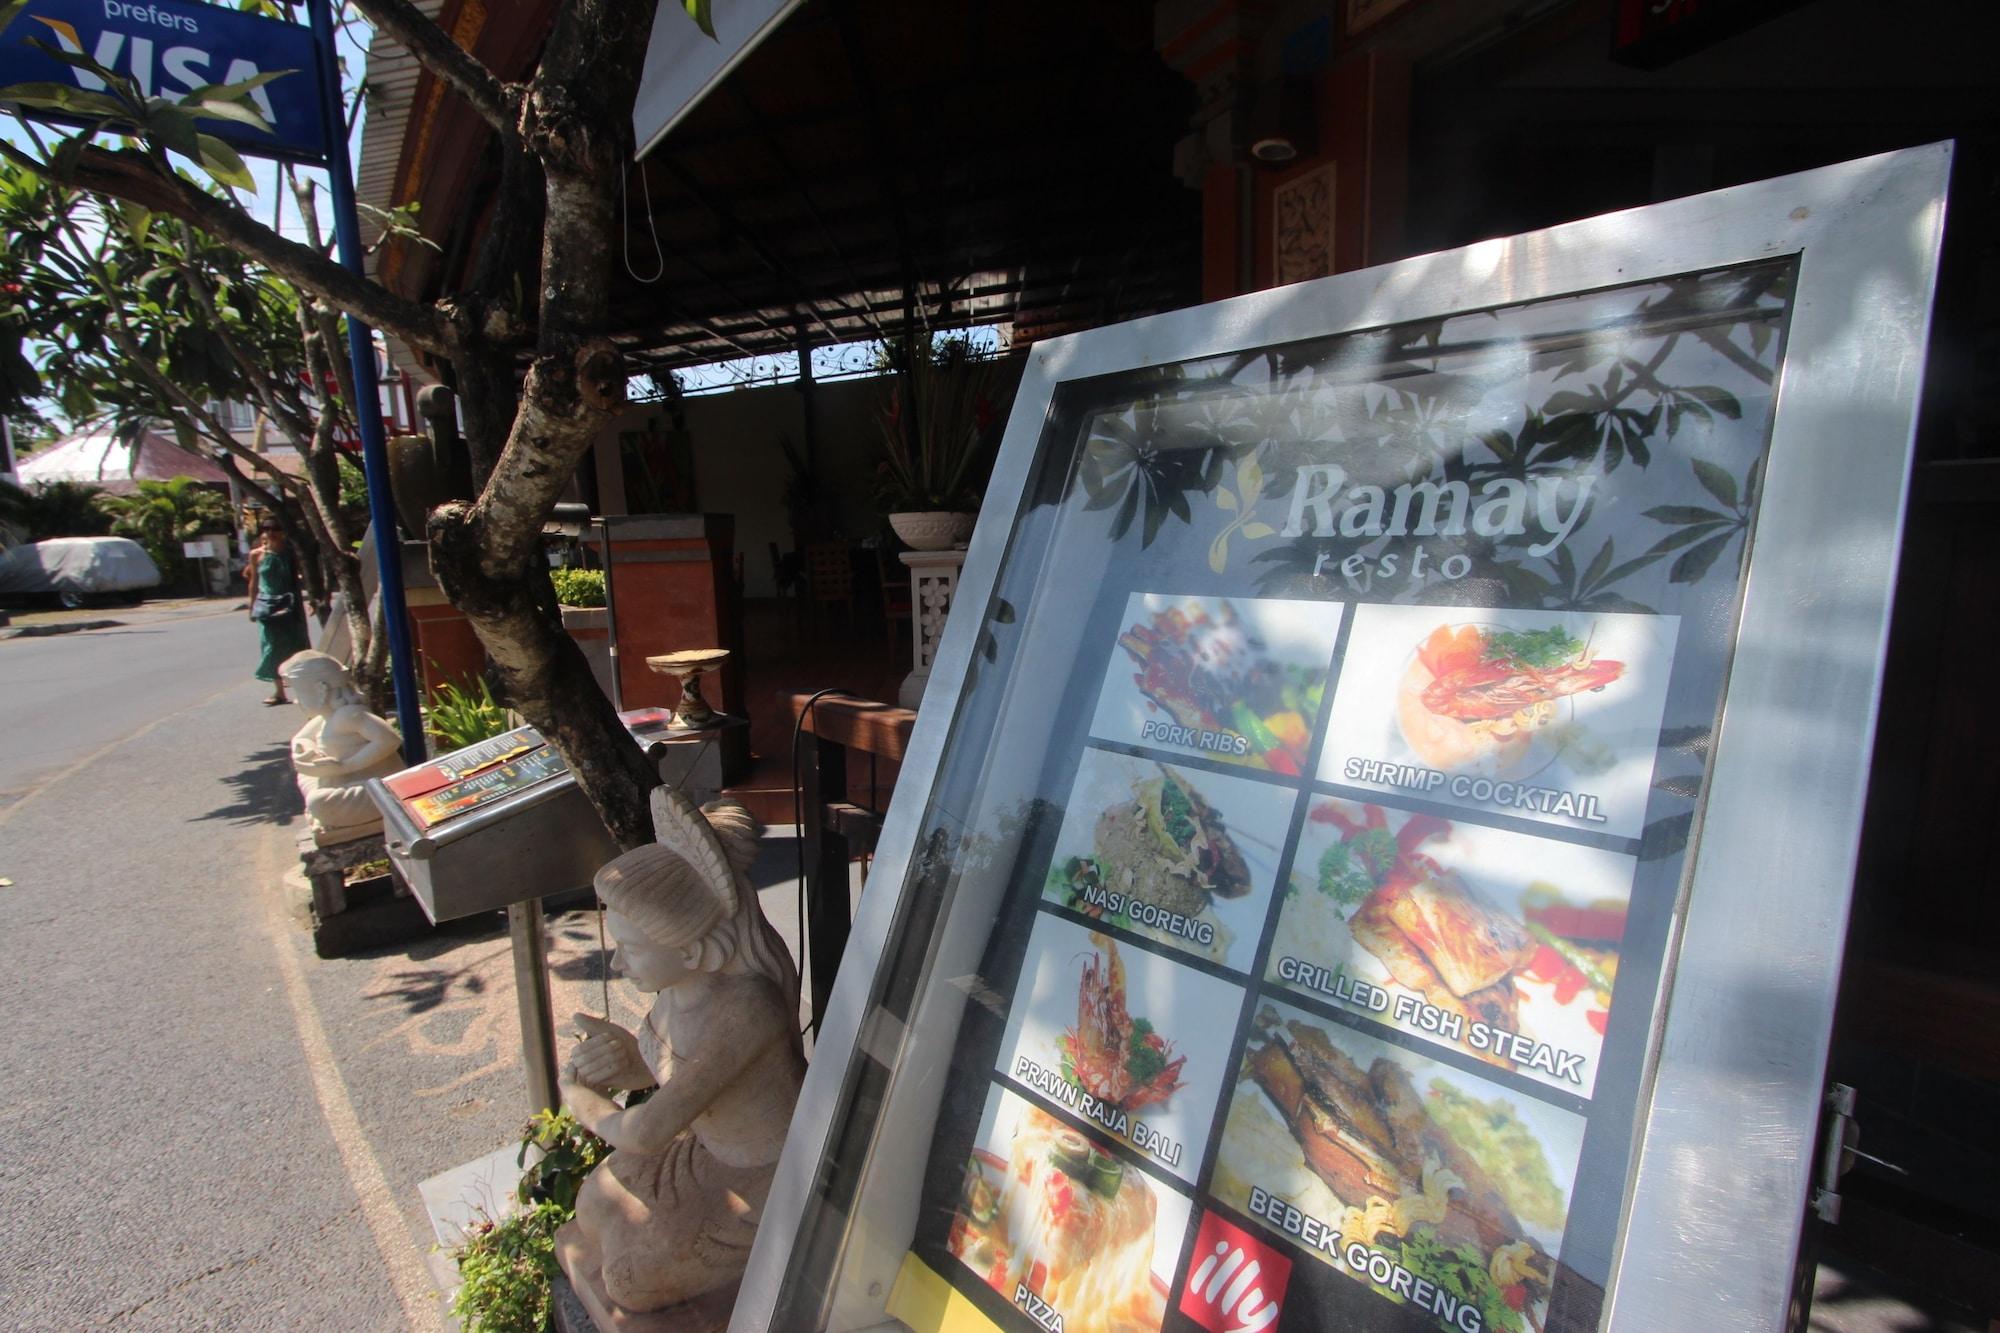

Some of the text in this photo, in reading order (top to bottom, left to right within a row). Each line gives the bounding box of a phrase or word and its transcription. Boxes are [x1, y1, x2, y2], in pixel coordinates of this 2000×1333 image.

[104, 0, 199, 33] prefers
[30, 15, 278, 125] VISA
[1280, 463, 1596, 557] Ramay
[1313, 544, 1473, 580] resto
[1142, 720, 1249, 755] PORK RIBS
[1344, 757, 1607, 823] SHRIMP COCKTAIL
[1083, 885, 1214, 945] NASI GORENG
[1277, 956, 1586, 1086] GRILLED FISH STEAK
[1016, 1056, 1183, 1168] PRAWN RAJA BALI
[1189, 1240, 1279, 1333] illy
[1248, 1187, 1482, 1333] BEBEK GORENG
[1014, 1281, 1065, 1333] PIZZA
